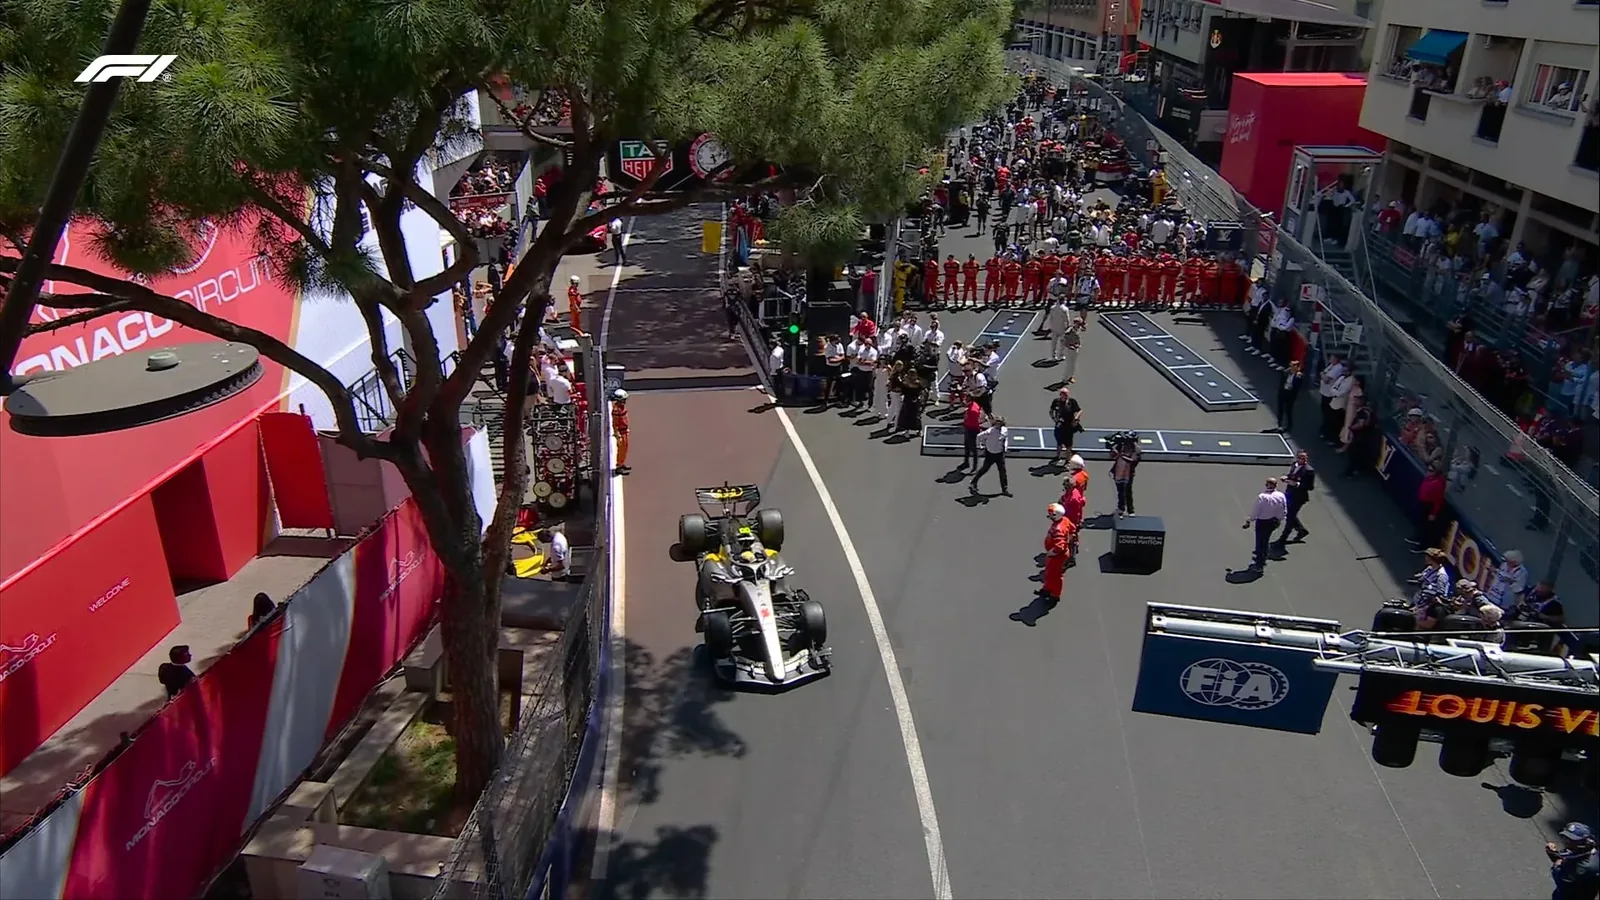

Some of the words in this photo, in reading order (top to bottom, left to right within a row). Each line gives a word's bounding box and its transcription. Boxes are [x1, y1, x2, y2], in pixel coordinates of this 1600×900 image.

[624, 161, 670, 178] HEU
[88, 576, 131, 613] WELCOME
[0, 632, 57, 682] ACOCIRCUIT
[1406, 690, 1544, 729] LOUIS
